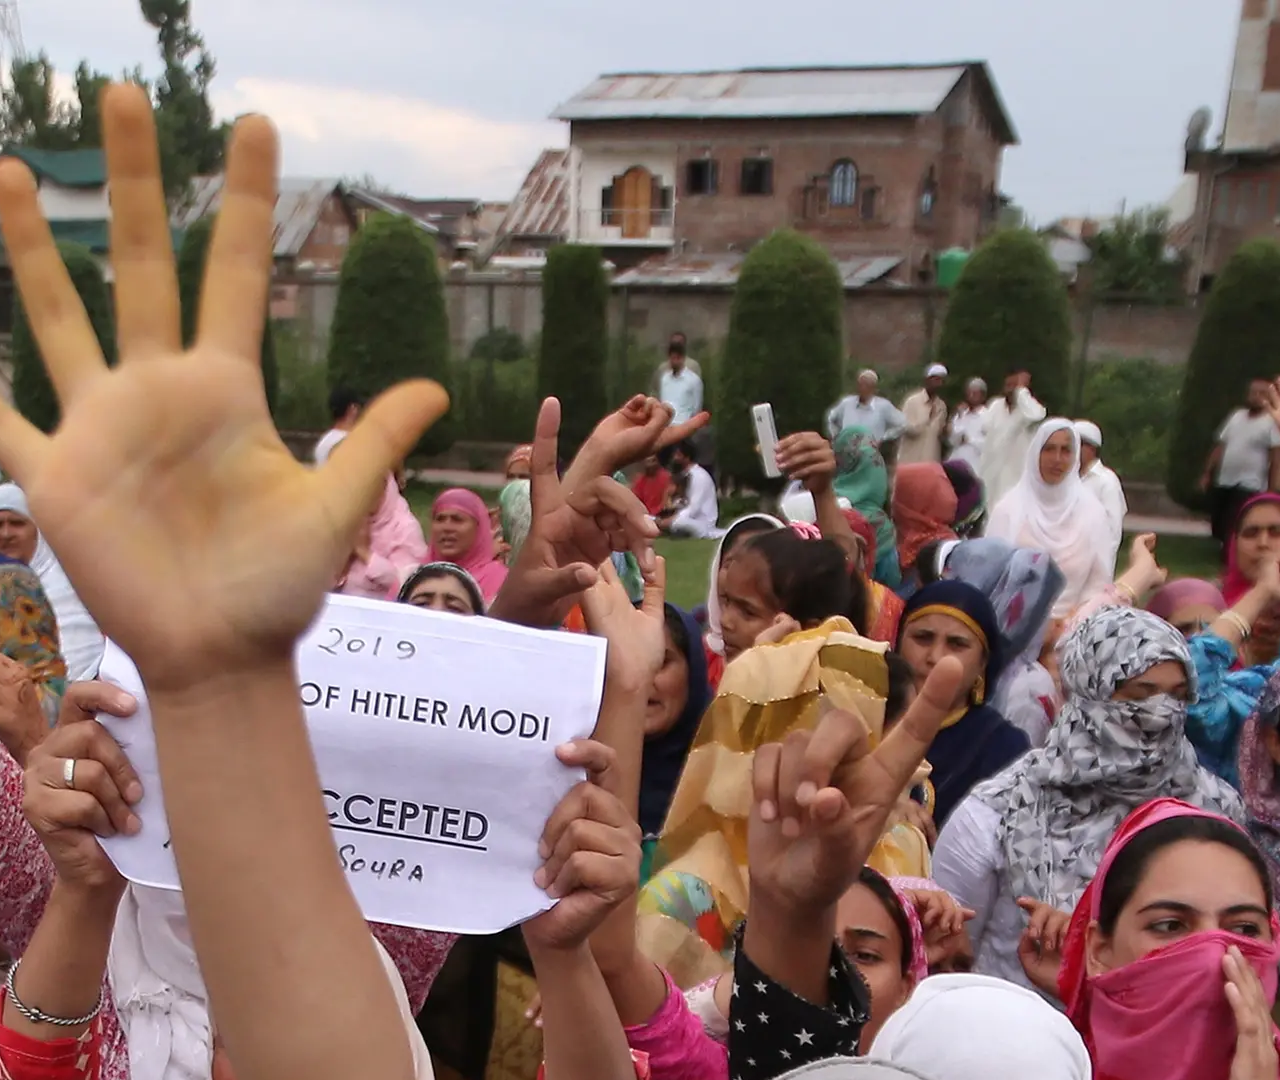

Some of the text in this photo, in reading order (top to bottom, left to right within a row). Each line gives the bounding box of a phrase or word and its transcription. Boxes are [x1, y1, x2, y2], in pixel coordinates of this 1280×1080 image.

[318, 628, 417, 660] 2019
[300, 682, 550, 742] OF HITLER MODI
[321, 789, 489, 842] CCEPTED
